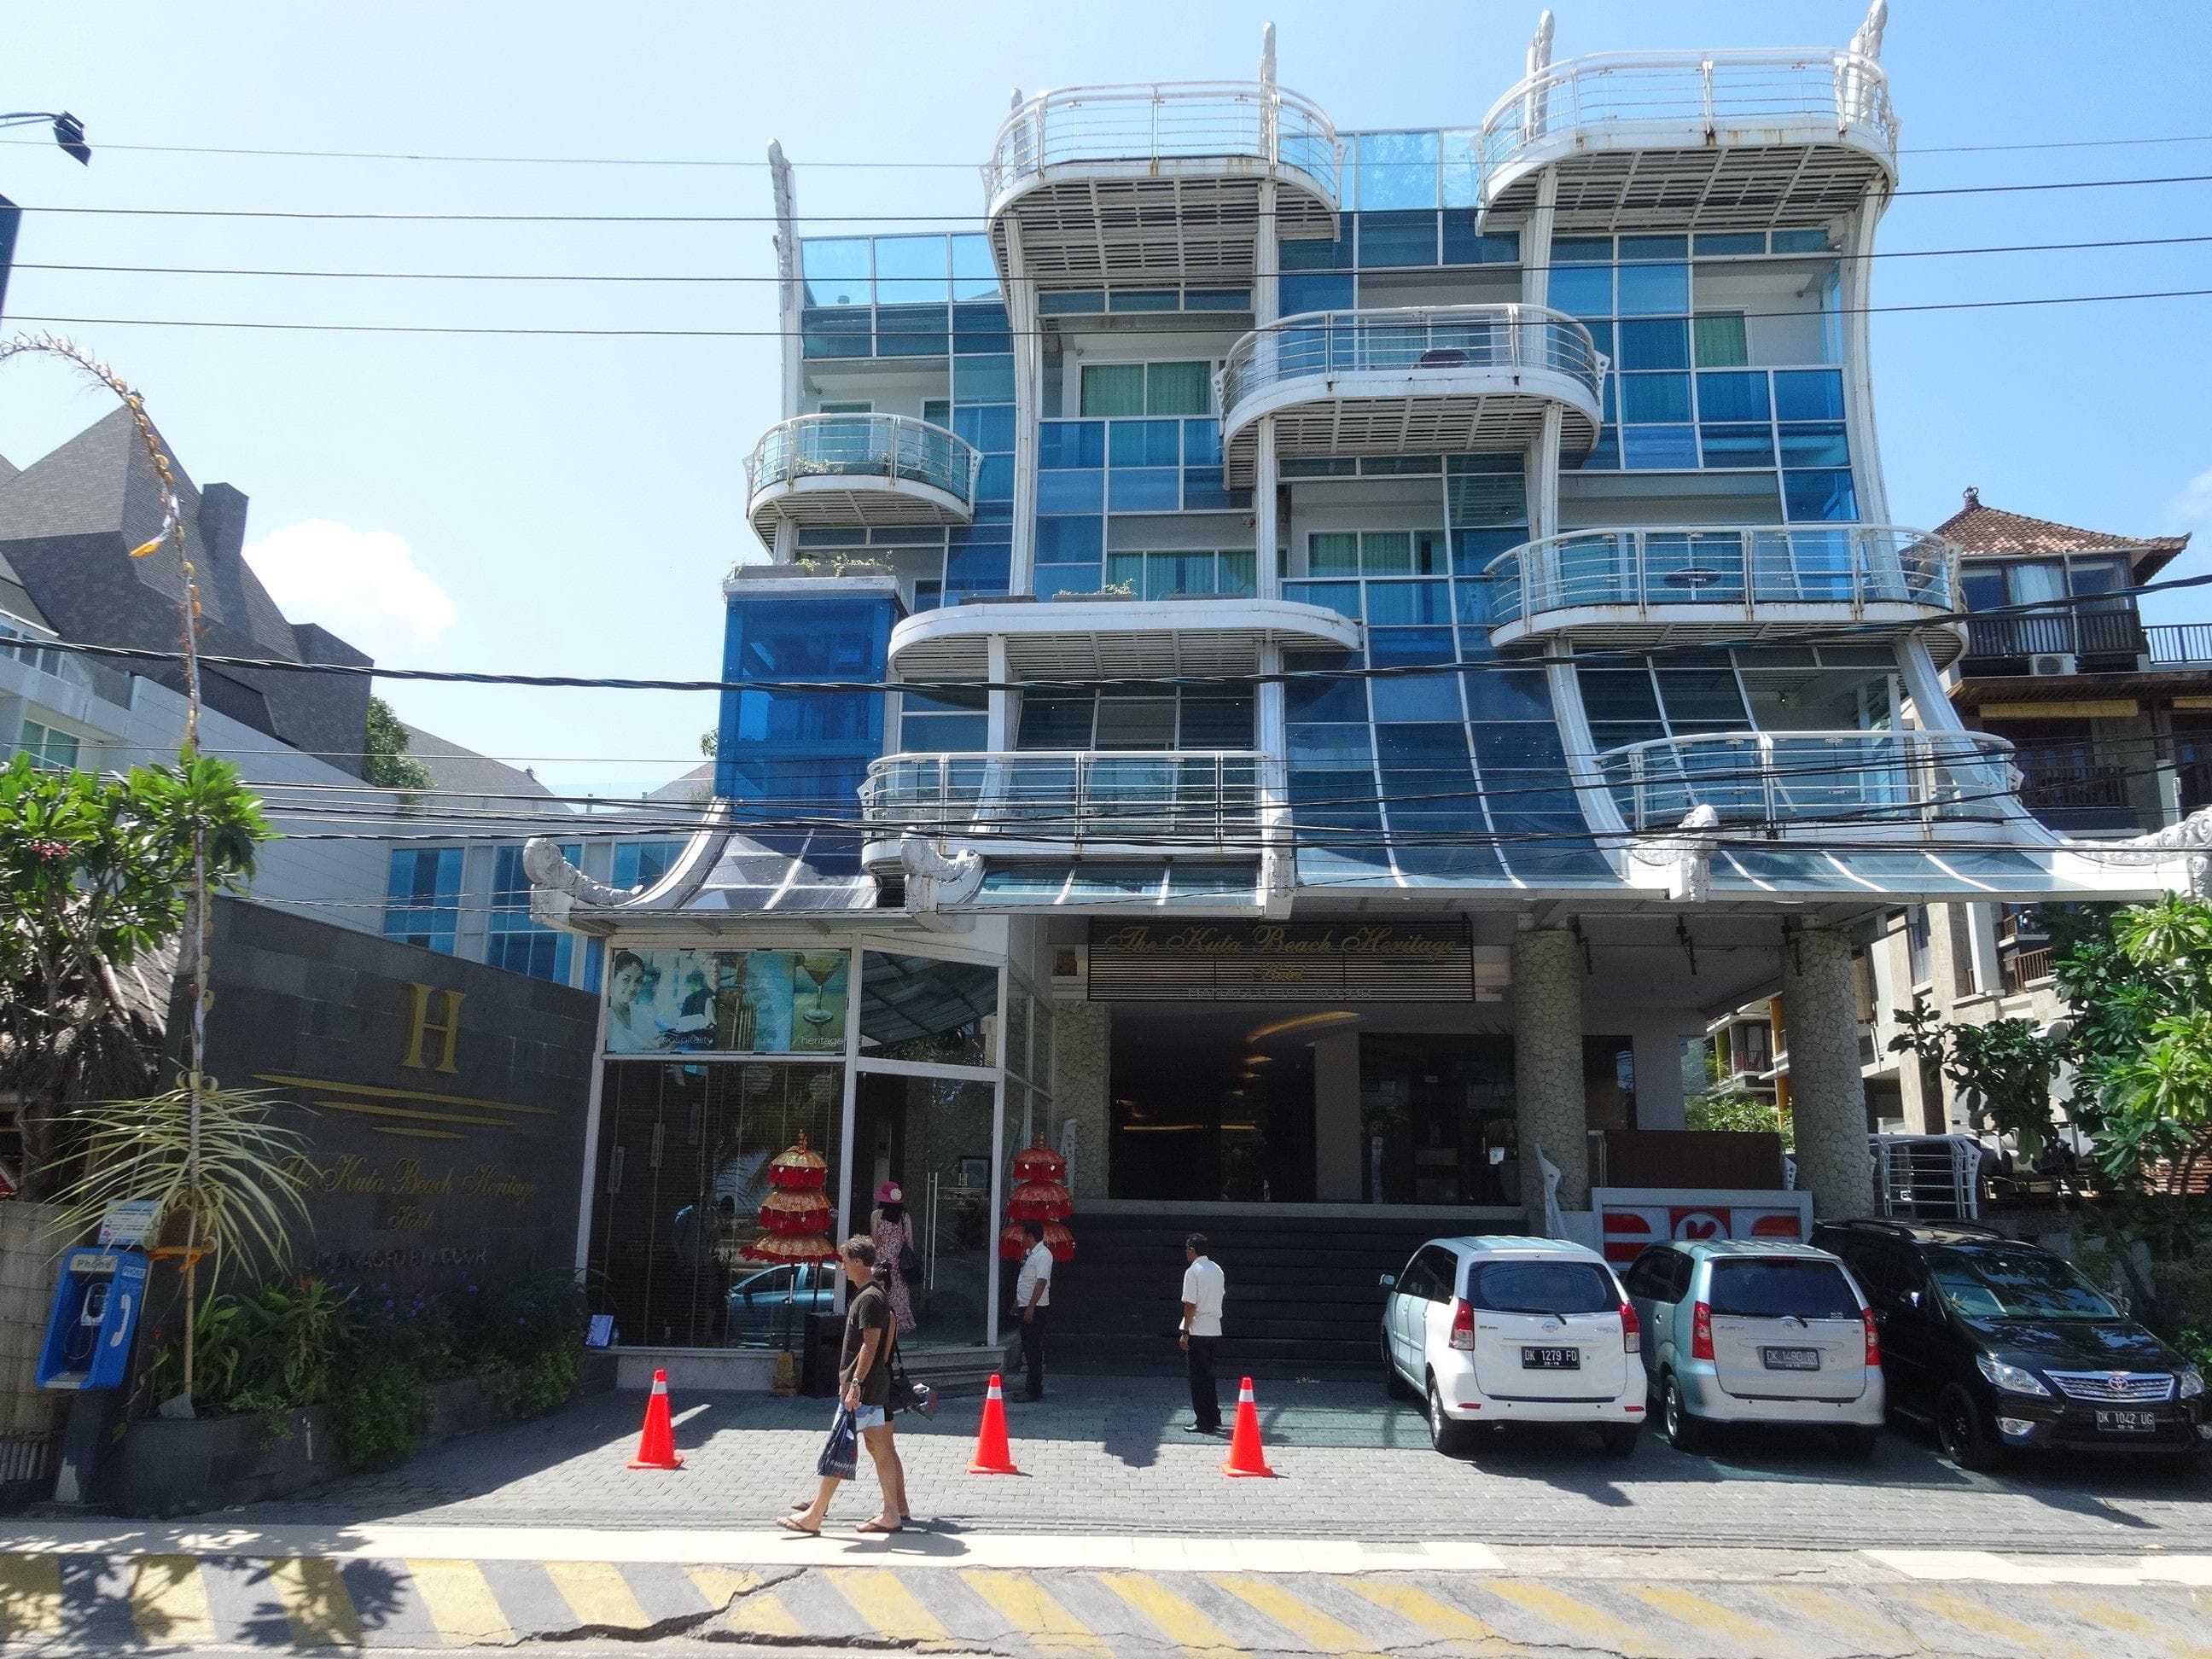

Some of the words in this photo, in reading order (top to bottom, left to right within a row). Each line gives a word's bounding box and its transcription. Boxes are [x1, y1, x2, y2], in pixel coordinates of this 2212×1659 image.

[1104, 925, 1157, 953] The
[1166, 925, 1241, 953] Kuta
[1251, 923, 1333, 954] Beach
[1342, 925, 1456, 963] Heritage
[1250, 963, 1307, 981] Hotel
[401, 982, 467, 1074] H
[800, 1035, 844, 1047] heritage
[319, 1153, 383, 1194] Kuta
[392, 1157, 454, 1196] Beach
[124, 1266, 145, 1278] PHONE
[1525, 1349, 1535, 1361] DK
[1541, 1349, 1562, 1361] 1279
[1767, 1349, 1778, 1361] DK
[2098, 1412, 2109, 1423] DK
[2115, 1412, 2136, 1424] 1042
[2140, 1413, 2153, 1425] UG
